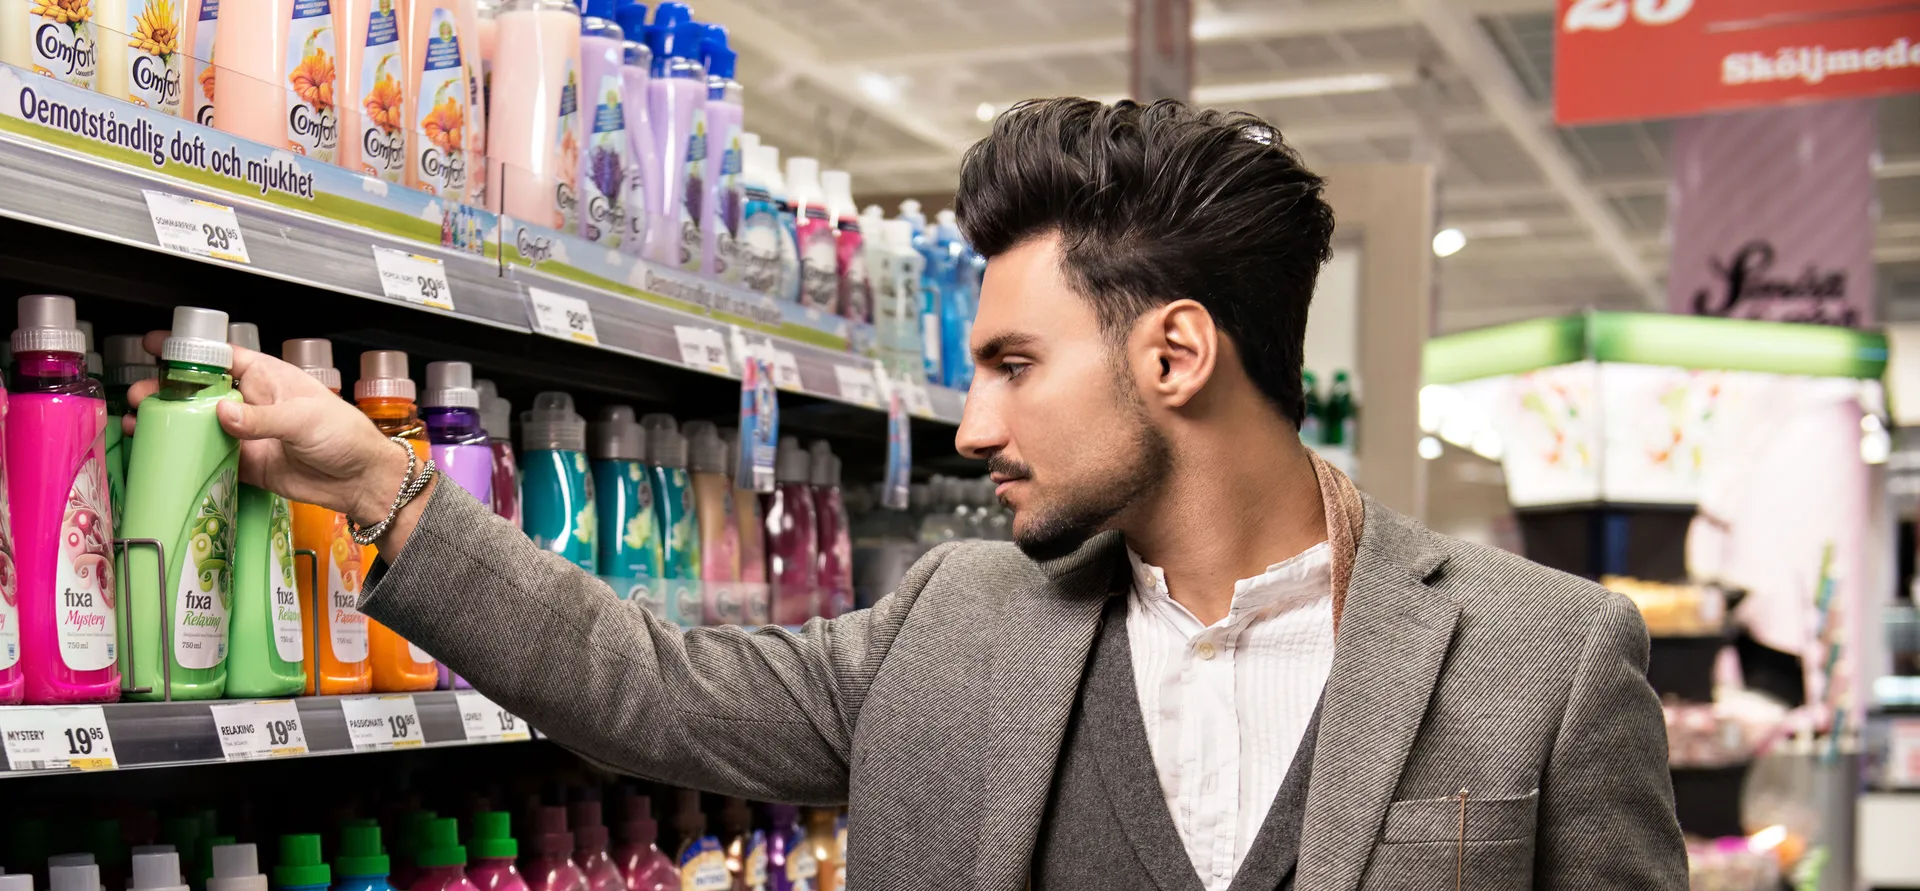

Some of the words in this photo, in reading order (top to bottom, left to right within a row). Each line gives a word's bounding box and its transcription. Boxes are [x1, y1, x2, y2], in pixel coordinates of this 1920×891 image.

[36, 23, 95, 75] Comfort
[132, 56, 181, 104] Comfort
[289, 104, 337, 148] Comfort
[20, 87, 164, 165] Oemotståndlig
[171, 130, 206, 168] doft
[212, 147, 241, 178] och
[247, 158, 314, 198] mjukhet
[64, 588, 92, 607] fixa
[186, 590, 212, 610] fixa
[277, 587, 294, 605] fixa
[334, 591, 354, 608] fixa
[64, 610, 106, 631] Mystery
[183, 611, 221, 632] Relaxing
[67, 641, 79, 649] 750
[221, 724, 255, 736] RELAXING
[349, 718, 384, 727] PASSIONATE
[7, 730, 45, 741] MYSTERY
